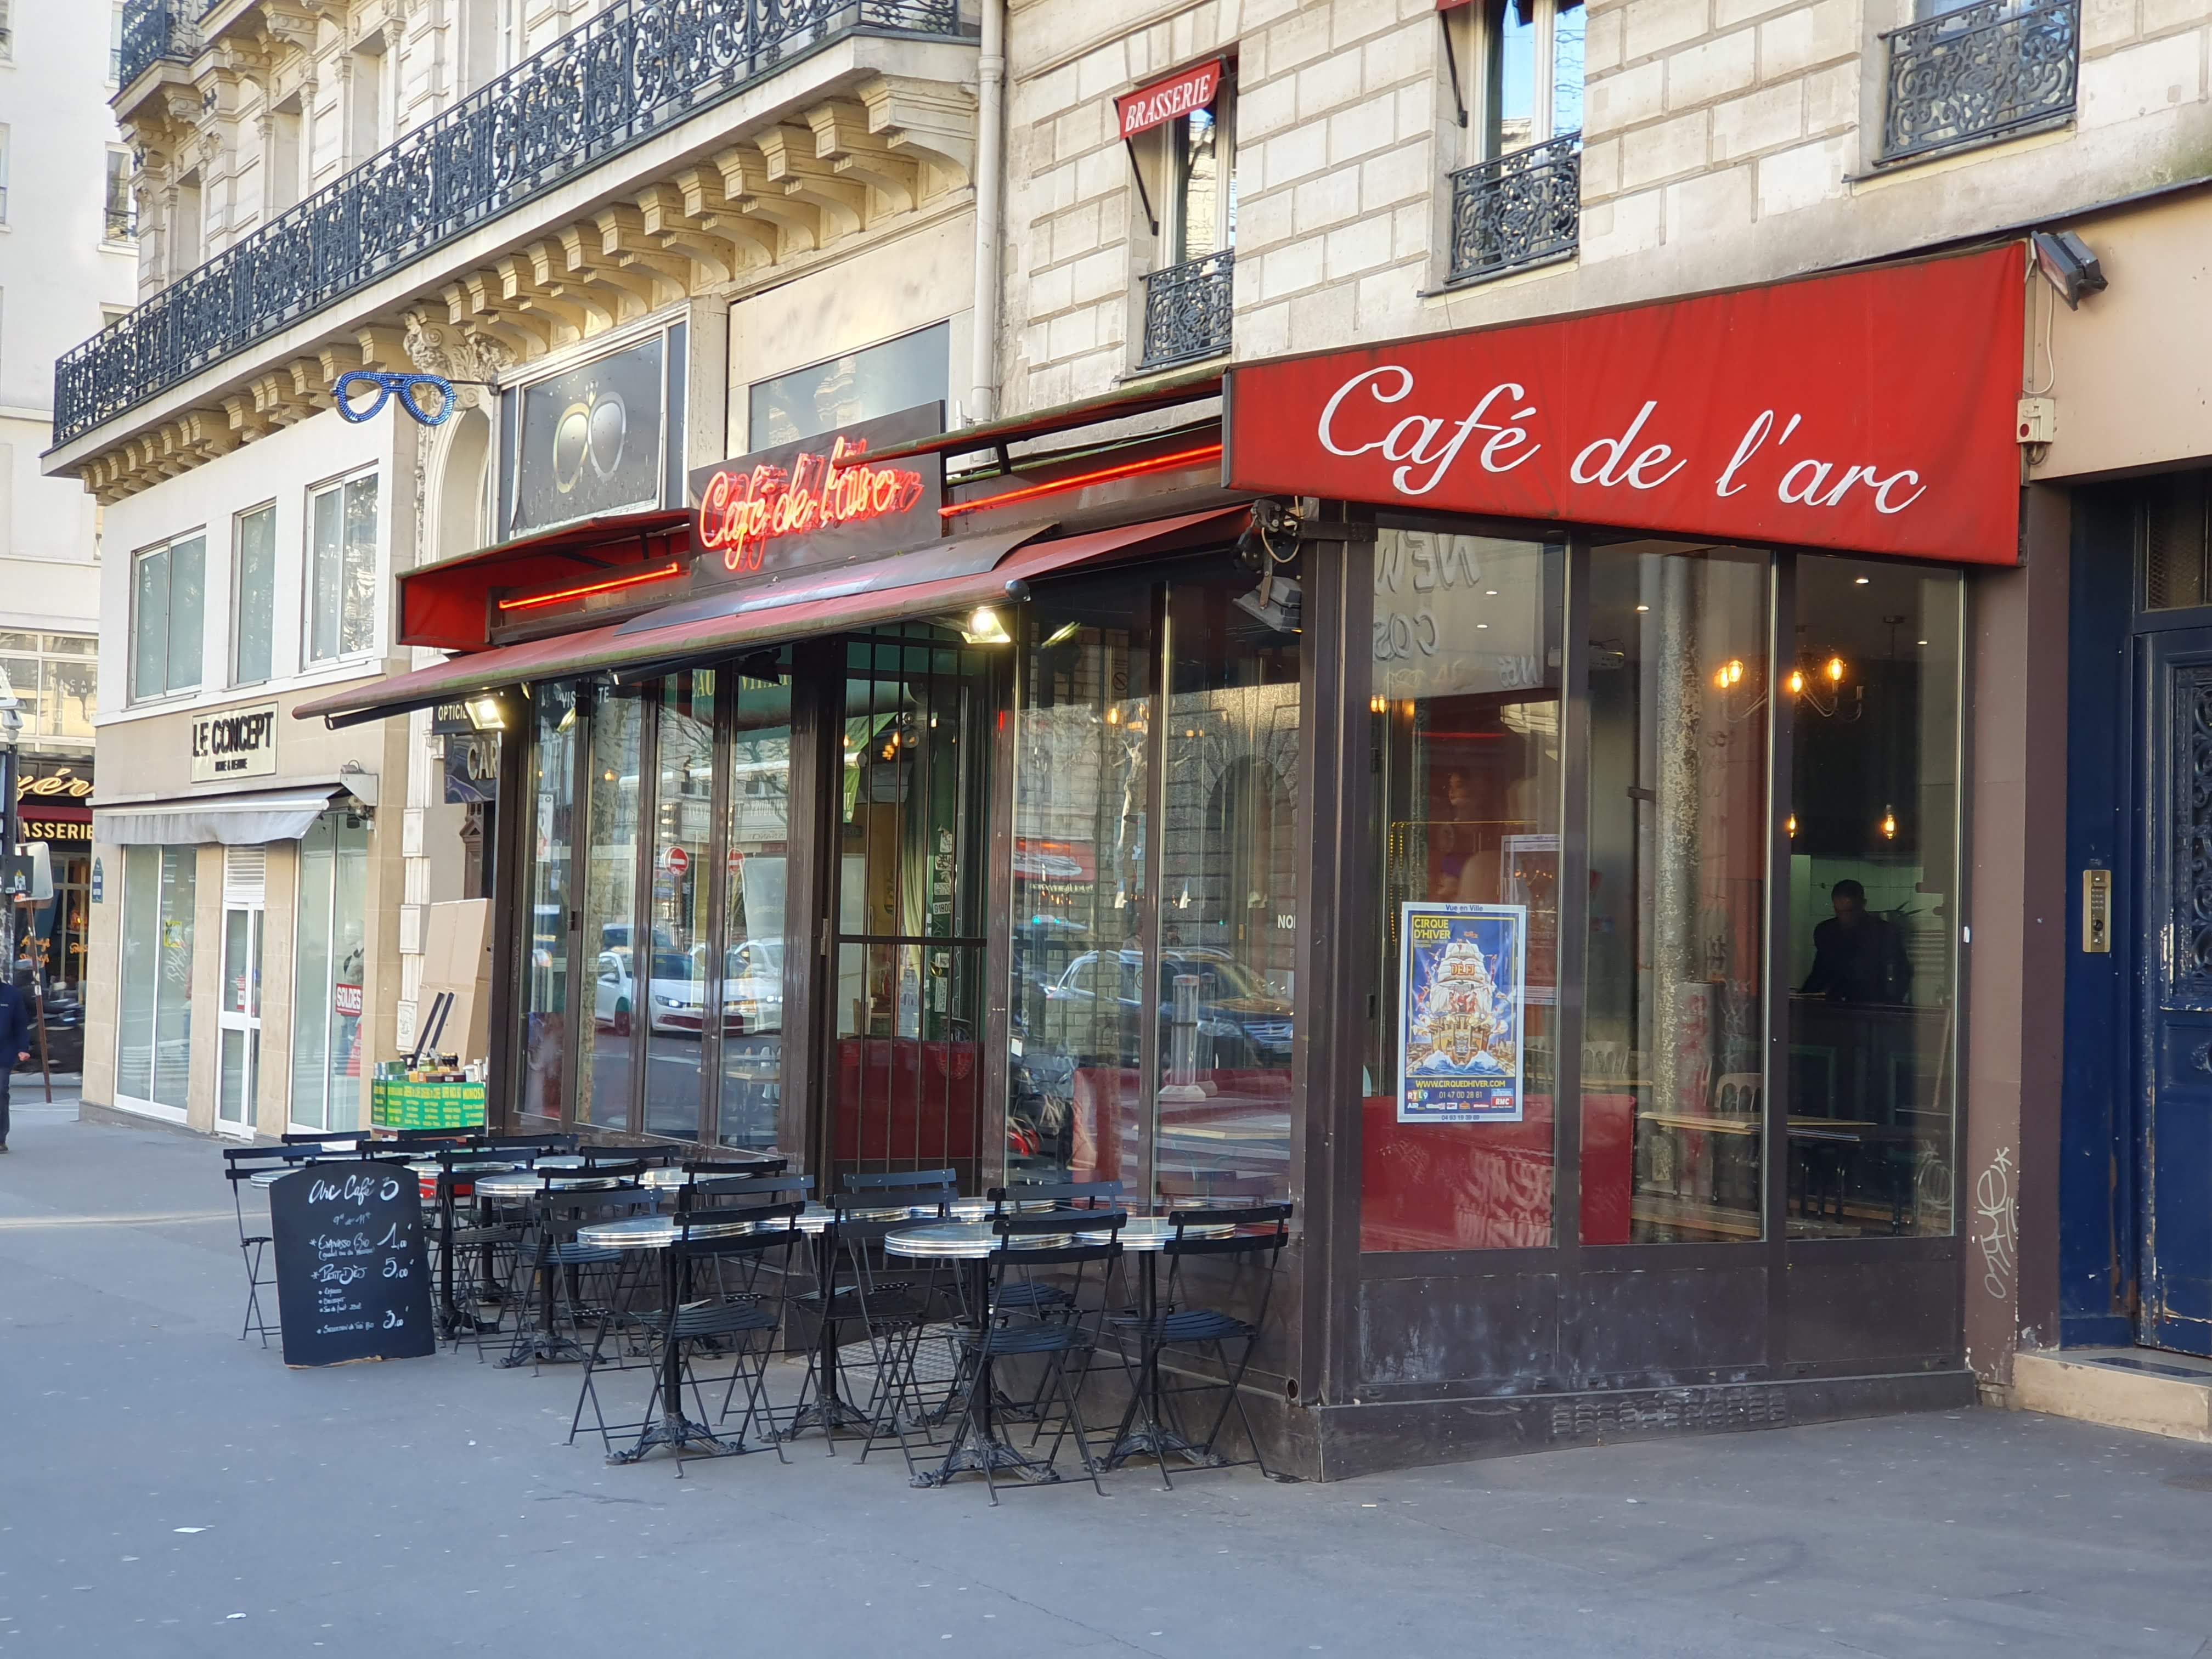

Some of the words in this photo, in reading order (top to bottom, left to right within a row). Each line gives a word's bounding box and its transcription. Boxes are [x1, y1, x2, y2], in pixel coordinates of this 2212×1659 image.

[1125, 74, 1211, 132] BRASSERIE
[1317, 364, 1541, 495] Café
[1570, 400, 1687, 490] de
[1717, 409, 1927, 514] l'arc
[772, 453, 819, 533] de
[193, 722, 209, 757] LE
[212, 711, 274, 755] CONCEPT
[1414, 919, 1449, 929] CIRQUE
[1414, 930, 1451, 939] D'HIVER
[336, 986, 362, 1009] SOLDES
